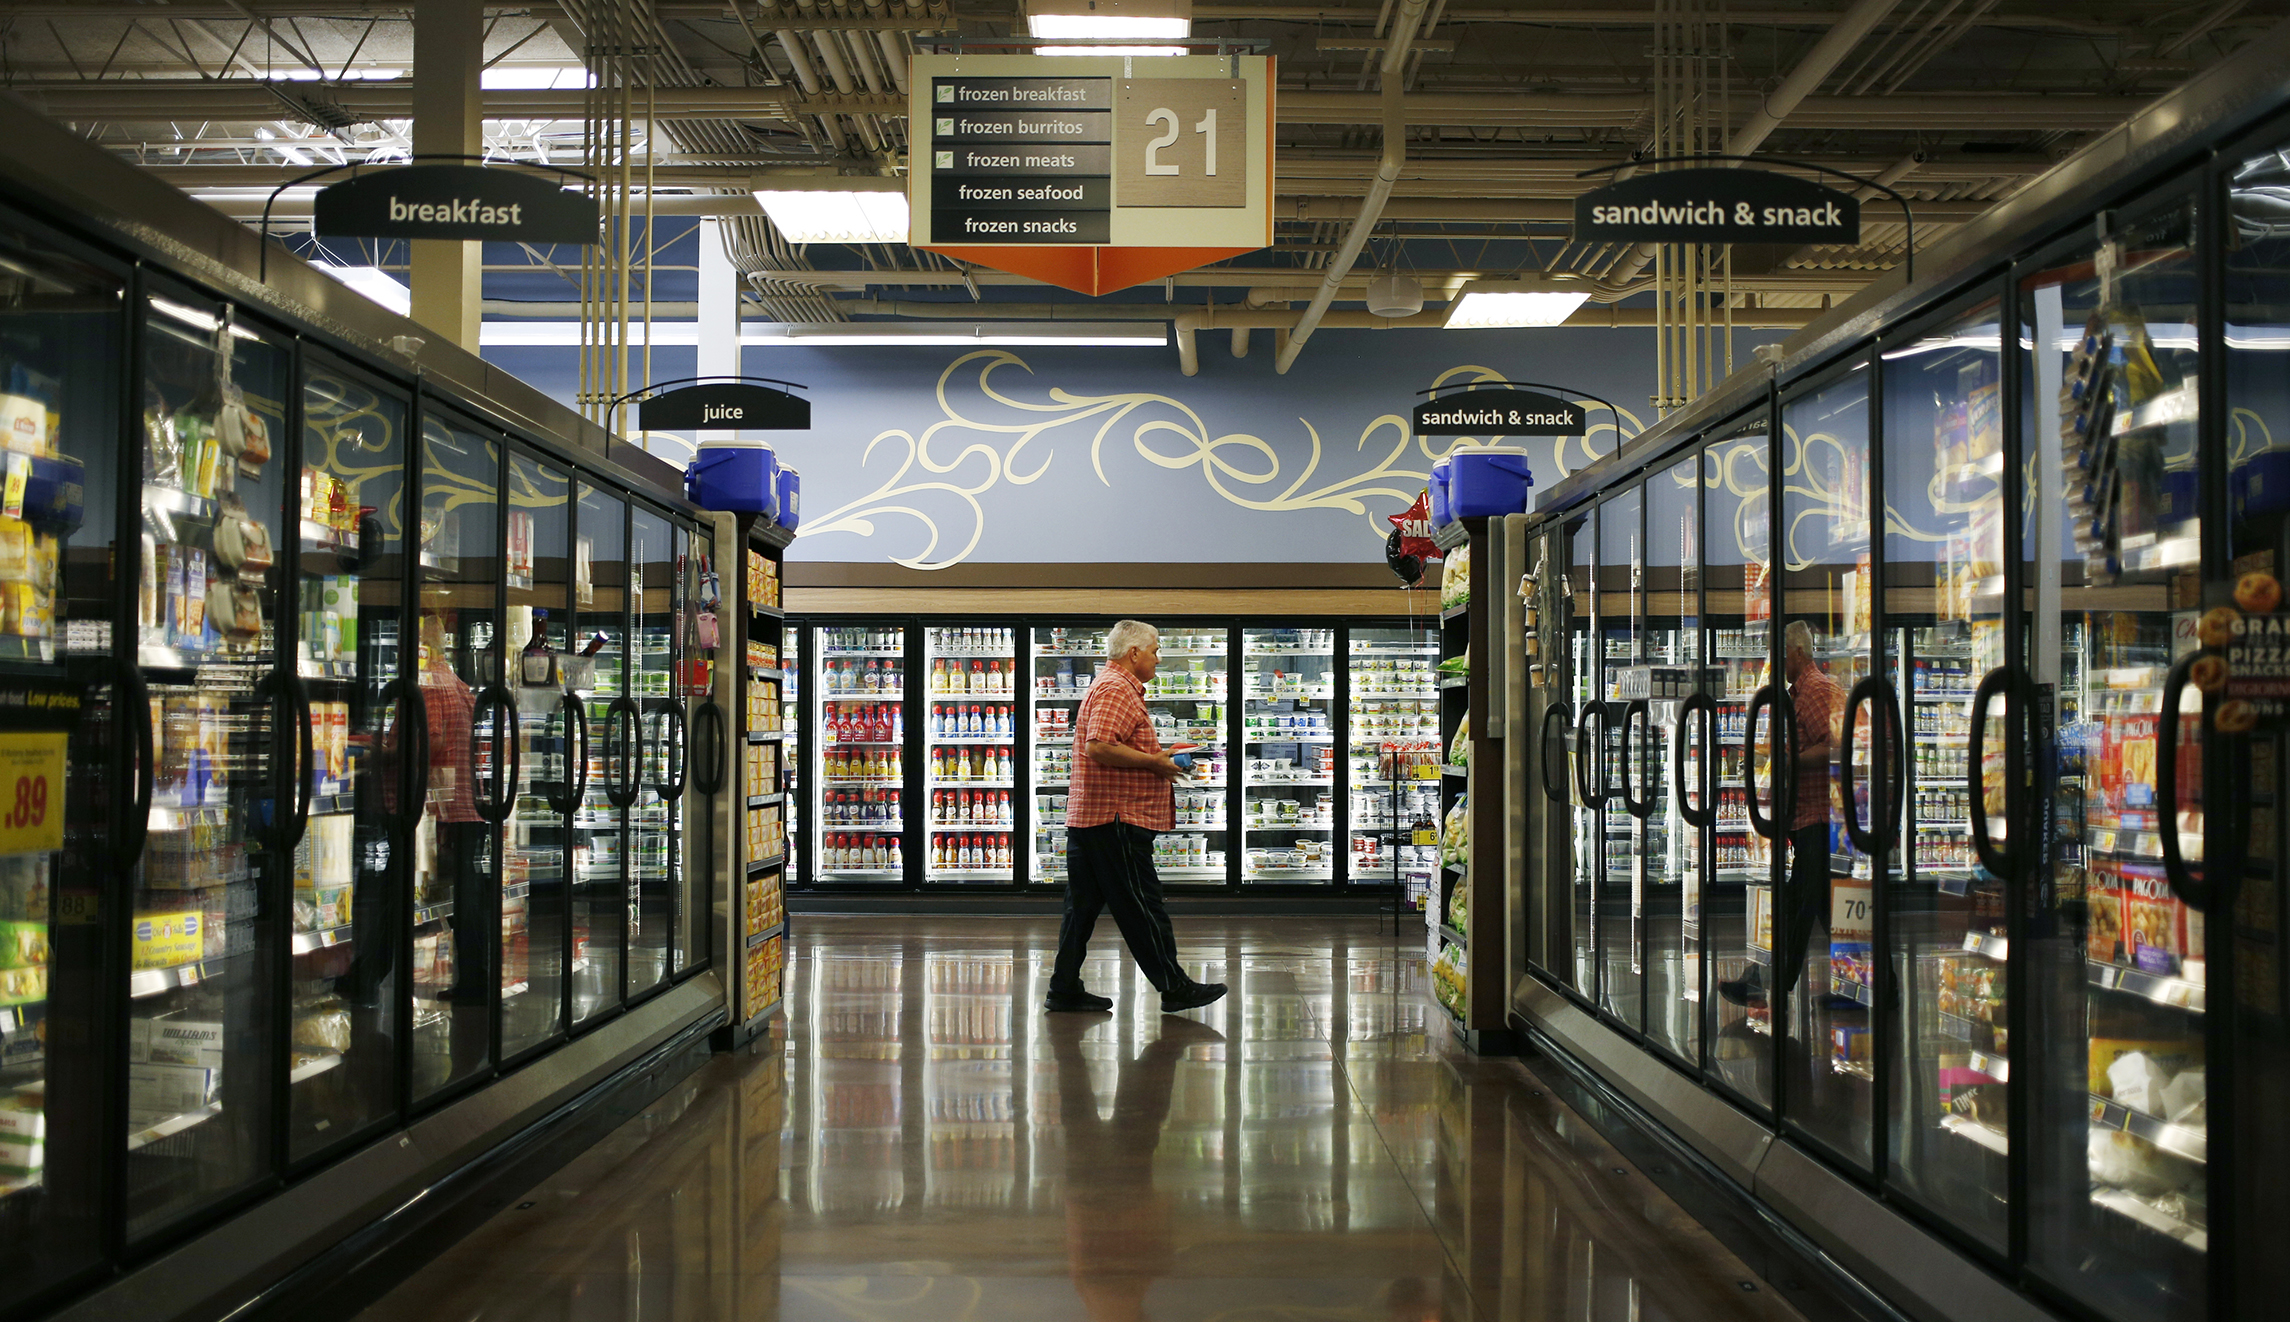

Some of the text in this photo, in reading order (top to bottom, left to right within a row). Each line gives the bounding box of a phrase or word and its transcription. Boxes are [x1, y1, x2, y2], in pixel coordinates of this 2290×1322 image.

[959, 86, 1086, 102] frozen breakfast
[959, 119, 1083, 135] frozen burritos
[1145, 107, 1217, 176] 21
[966, 152, 1075, 168] frozen meats
[959, 185, 1083, 201] frozen seafood
[389, 196, 522, 225] breakfast
[1592, 200, 1842, 226] sandwich & snack
[965, 218, 1077, 234] frozen snacks
[703, 404, 744, 423] juice
[1422, 409, 1574, 425] sandwich & snack
[27, 690, 47, 707] Low
[2132, 877, 2169, 900] PAGODA
[162, 1028, 217, 1041] WILLIAMS
